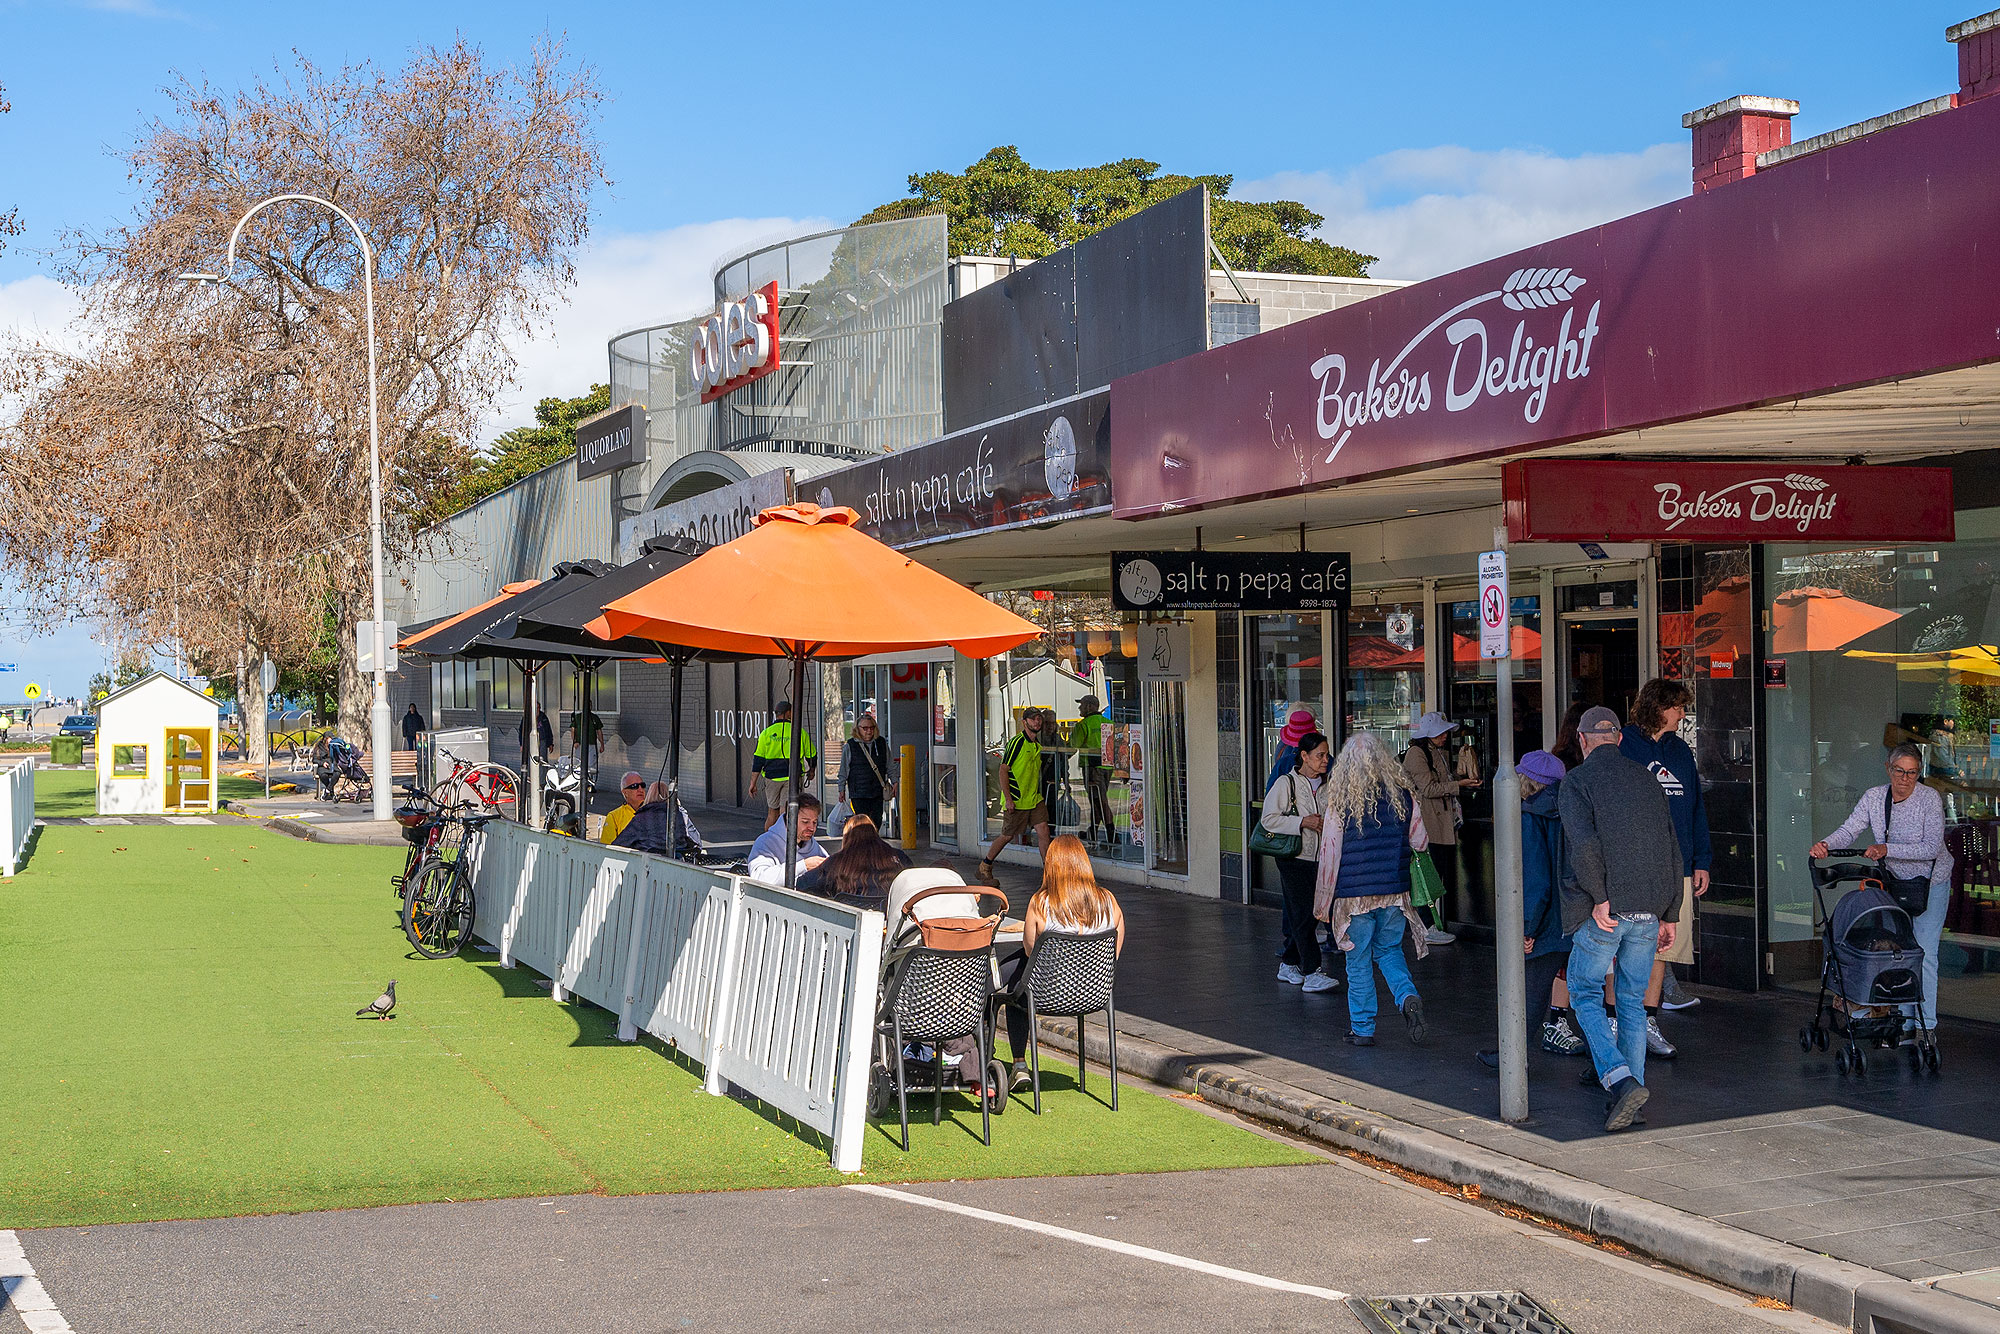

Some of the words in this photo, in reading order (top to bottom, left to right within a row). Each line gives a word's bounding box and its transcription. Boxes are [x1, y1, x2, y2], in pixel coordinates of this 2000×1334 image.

[690, 293, 769, 394] coles
[1310, 353, 1432, 463] Bakers
[1445, 299, 1600, 424] Delight
[580, 426, 632, 465] LIQUORLAND
[865, 467, 893, 528] salt
[896, 486, 907, 520] n
[911, 473, 951, 532] pepa
[956, 434, 994, 508] café
[1653, 482, 1741, 532] Bakers
[1750, 485, 1837, 533] Delight
[1118, 561, 1141, 577] salt
[1140, 575, 1148, 586] n
[1166, 561, 1208, 593] salt
[1216, 573, 1230, 592] n
[1239, 572, 1291, 599] pepa
[1300, 560, 1347, 593] café
[1481, 572, 1503, 580] PROHIBITED
[1134, 585, 1164, 603] pepa
[1300, 599, 1337, 609] 9398-1874
[1711, 661, 1732, 669] Midway
